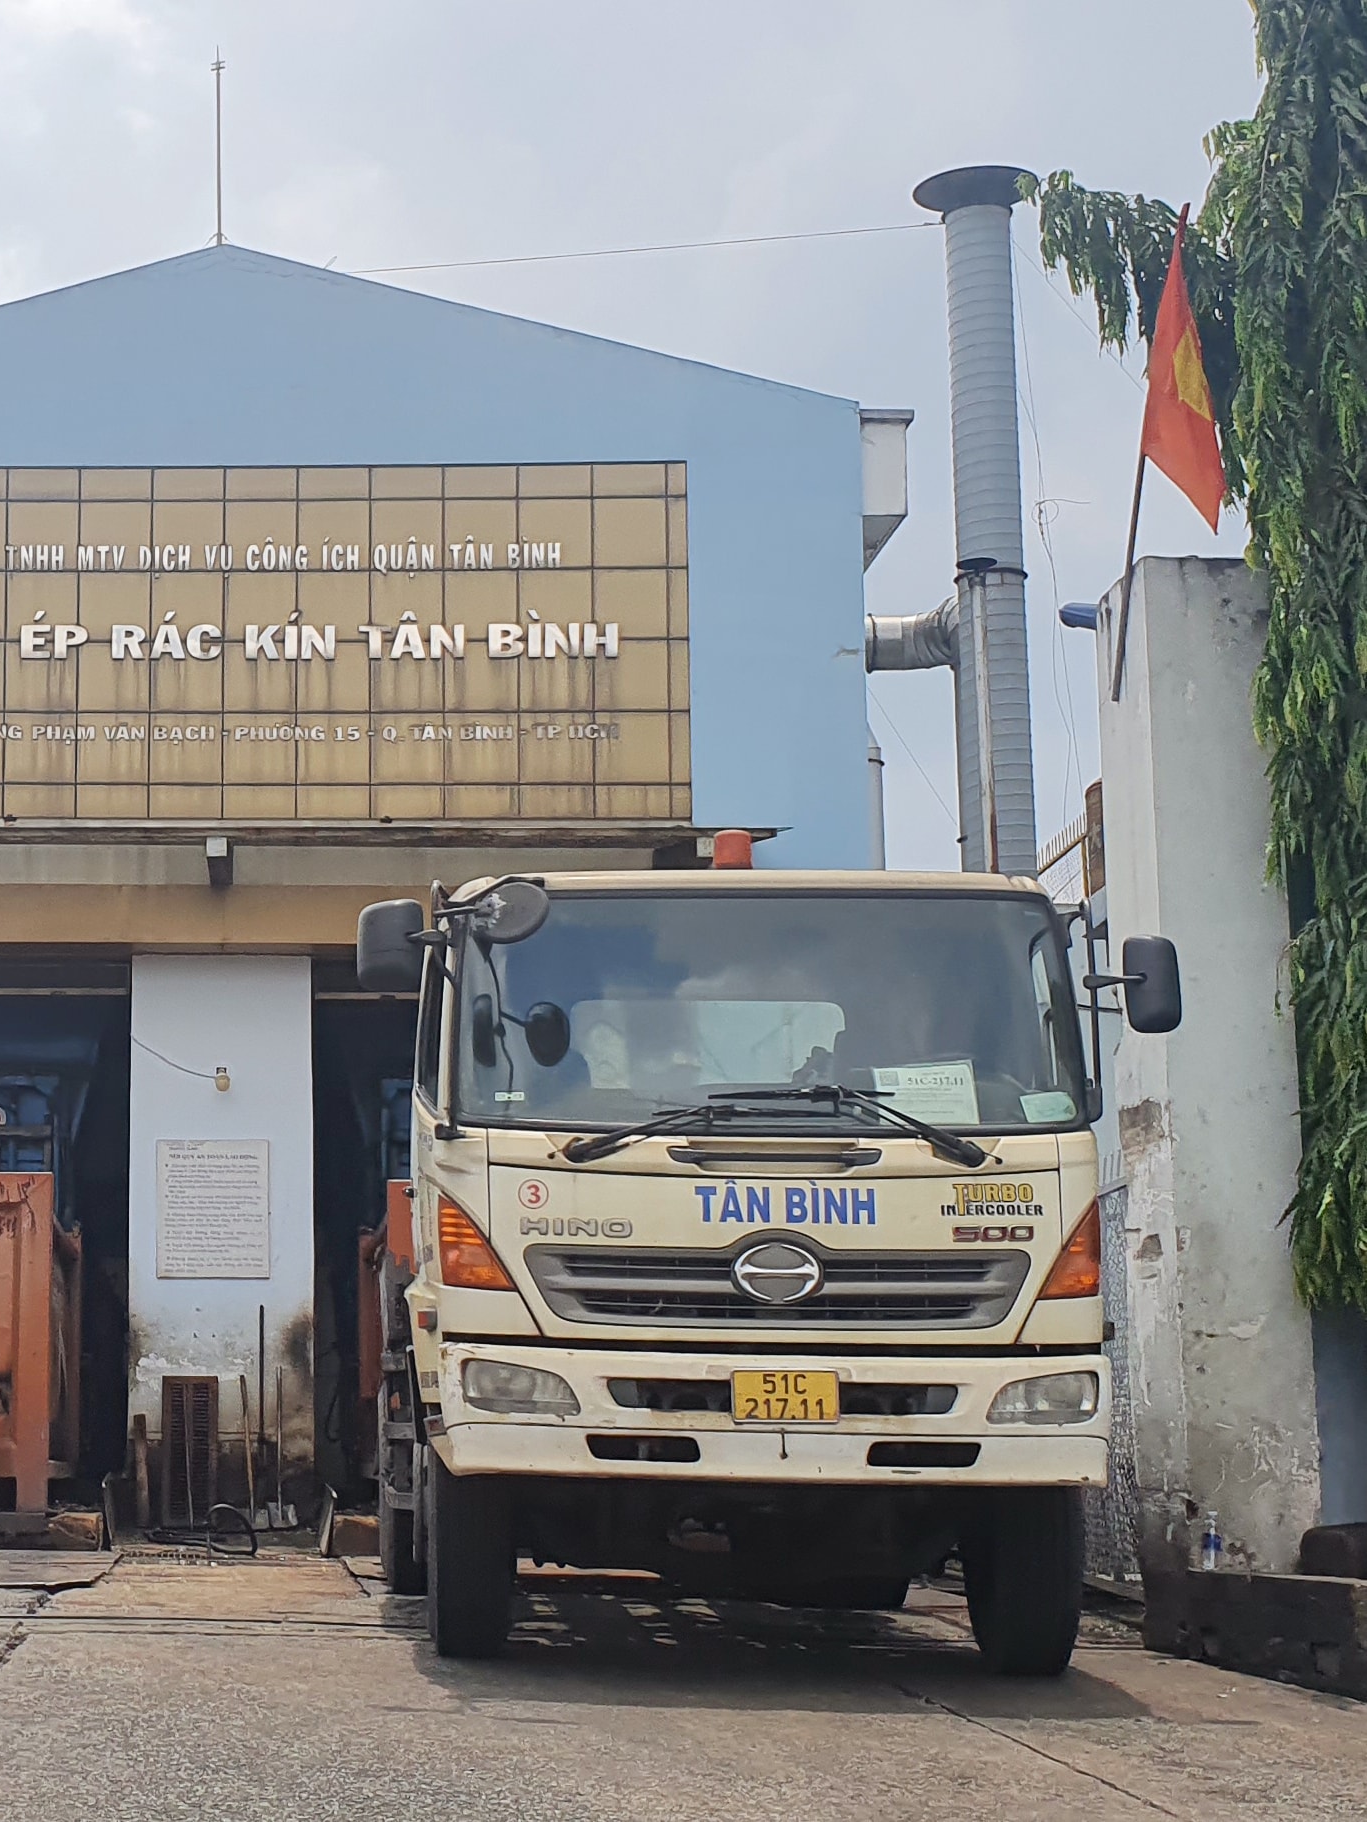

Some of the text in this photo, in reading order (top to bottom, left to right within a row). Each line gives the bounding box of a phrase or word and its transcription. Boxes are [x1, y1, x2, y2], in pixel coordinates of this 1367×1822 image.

[5, 544, 65, 571] TNHH
[77, 544, 126, 571] MTV
[138, 544, 191, 579] DỊCH
[204, 543, 233, 579] VỤ
[246, 536, 309, 571] CÔNG
[321, 537, 360, 571] ÍCH
[373, 536, 434, 579] QUẬN
[449, 535, 494, 570] TÂN
[506, 535, 562, 570] BÌNH
[20, 610, 89, 660] ÉP
[111, 610, 223, 660] RÁC
[244, 610, 336, 660] KÍN
[358, 610, 466, 660] TÂN
[487, 608, 620, 659] BÌNH
[32, 725, 96, 745] PHẠM
[103, 723, 146, 741] VĂN
[152, 725, 216, 745] BẠCH
[334, 726, 361, 741] 15
[408, 721, 453, 741] TÂN
[460, 721, 514, 741] BÌNH
[526, 1184, 541, 1205] 3
[694, 1179, 876, 1226] TÂN BÌNH
[952, 1183, 1034, 1216] TURBO
[519, 1217, 634, 1238] HINO
[952, 1225, 1035, 1242] 500
[762, 1373, 807, 1394] 51C
[745, 1398, 824, 1420] 217.11
